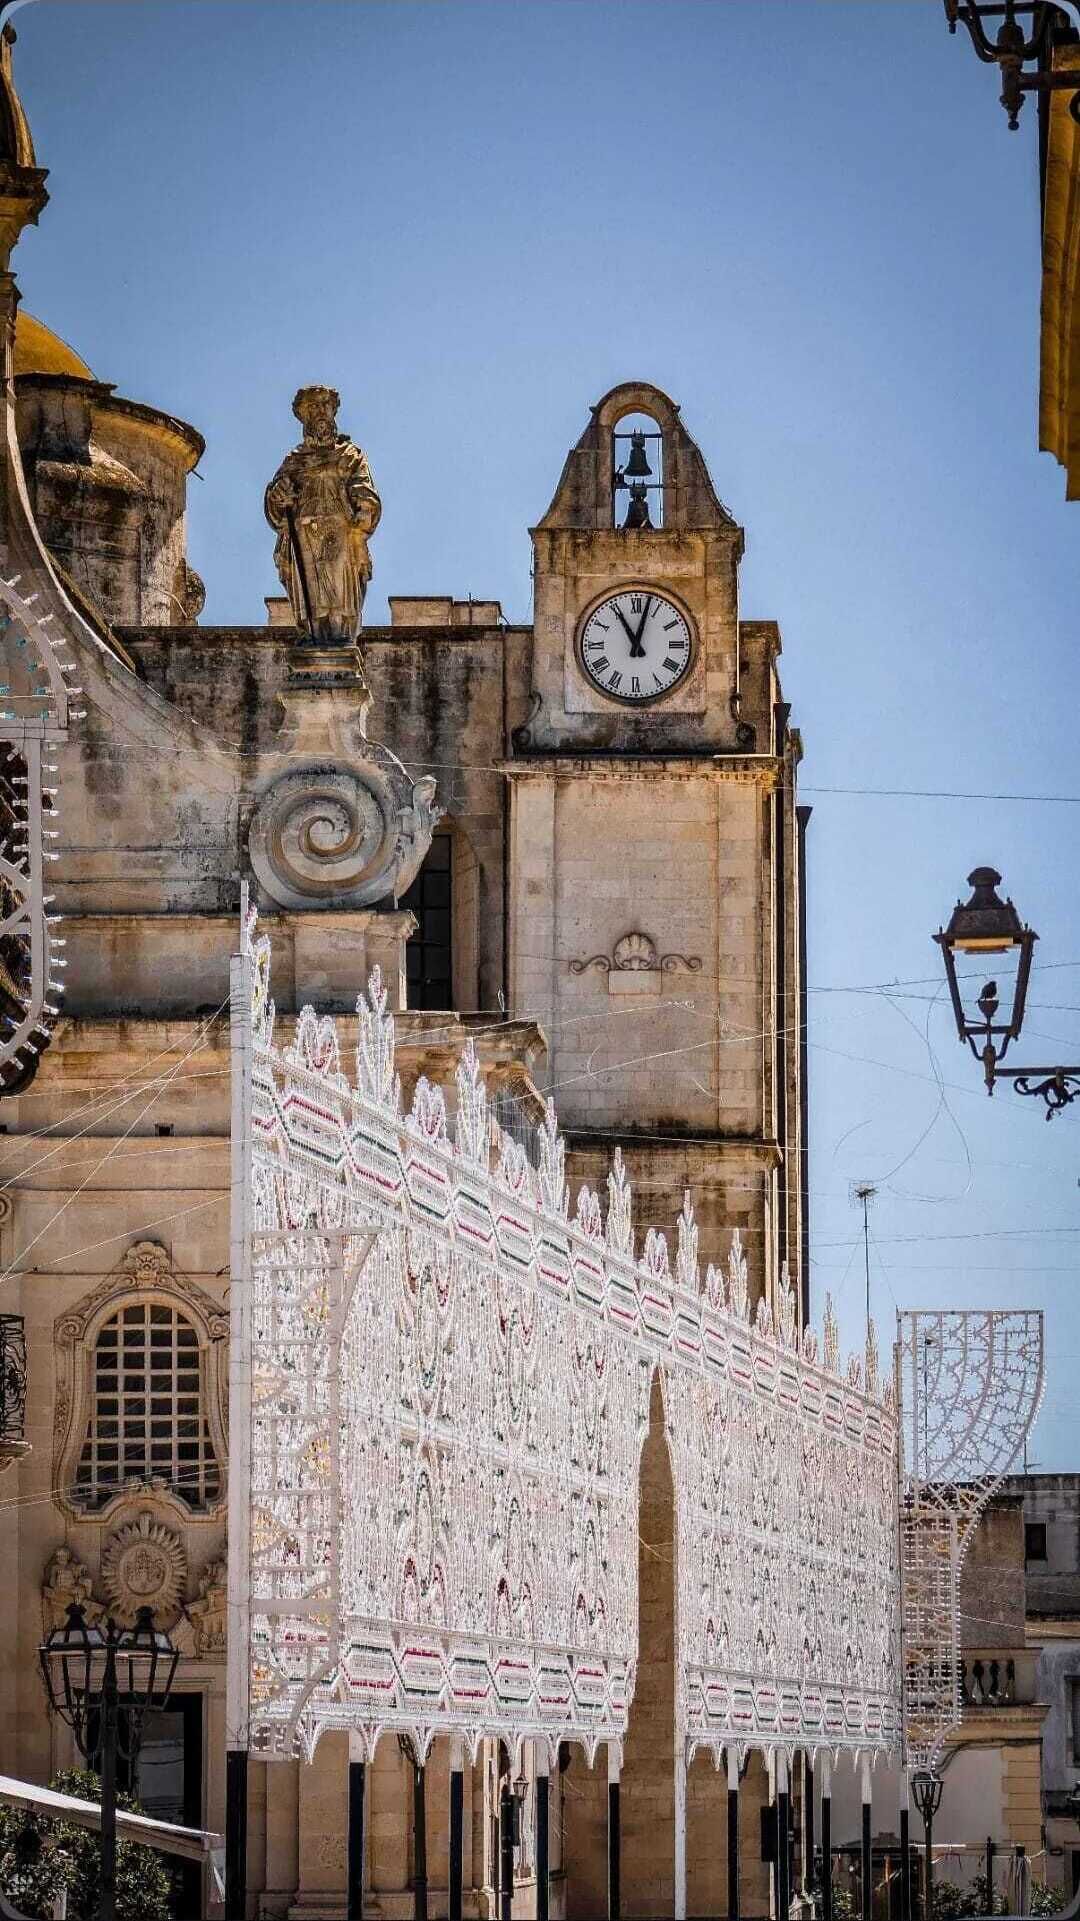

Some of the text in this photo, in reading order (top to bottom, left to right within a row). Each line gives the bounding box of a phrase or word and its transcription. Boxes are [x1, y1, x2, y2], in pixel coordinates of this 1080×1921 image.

[631, 597, 642, 614] XII
[651, 603, 661, 617] I
[593, 619, 610, 632] X
[663, 619, 679, 631] II
[588, 640, 605, 650] IX
[668, 640, 685, 649] III
[591, 656, 610, 674] VIII
[662, 657, 681, 673] IIII
[608, 670, 623, 689] VII
[631, 676, 641, 693] VI
[652, 673, 664, 688] V
